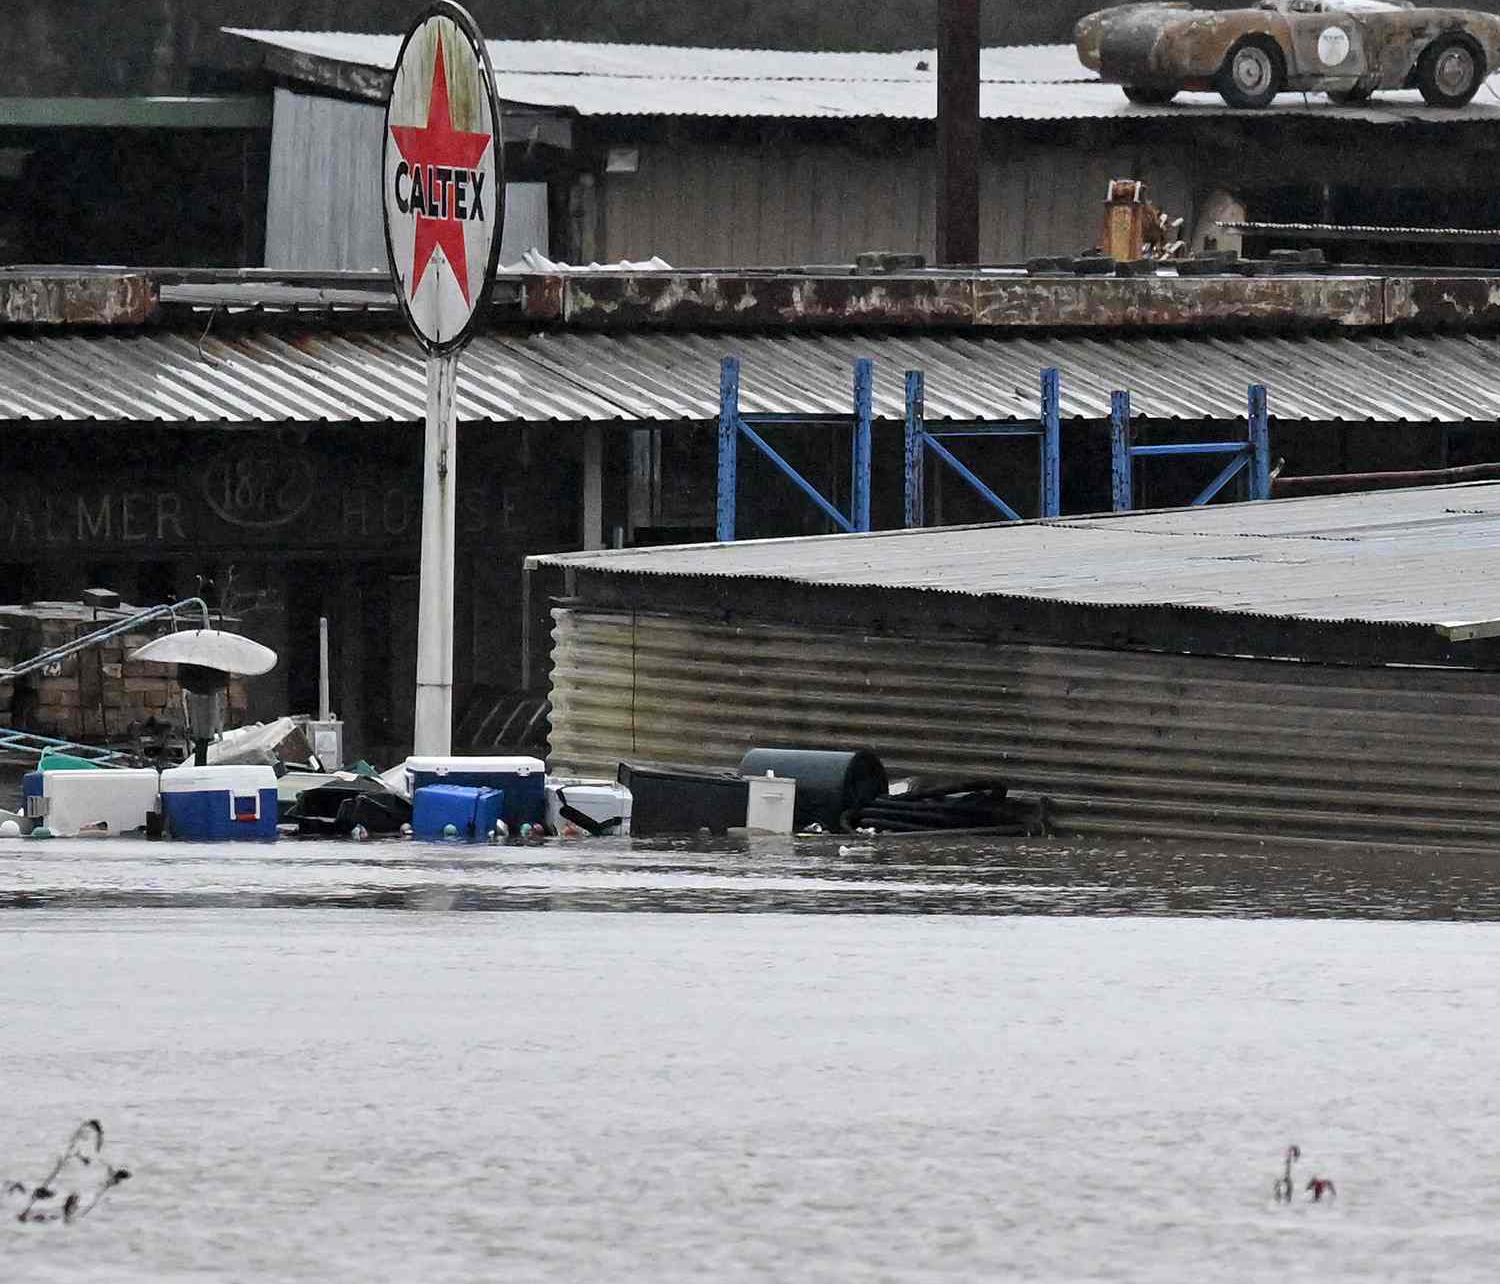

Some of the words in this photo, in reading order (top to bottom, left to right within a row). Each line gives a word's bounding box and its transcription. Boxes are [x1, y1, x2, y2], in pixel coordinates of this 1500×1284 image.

[395, 161, 485, 221] CALTEX
[0, 492, 187, 541] ALMER
[342, 487, 528, 535] HOSE
